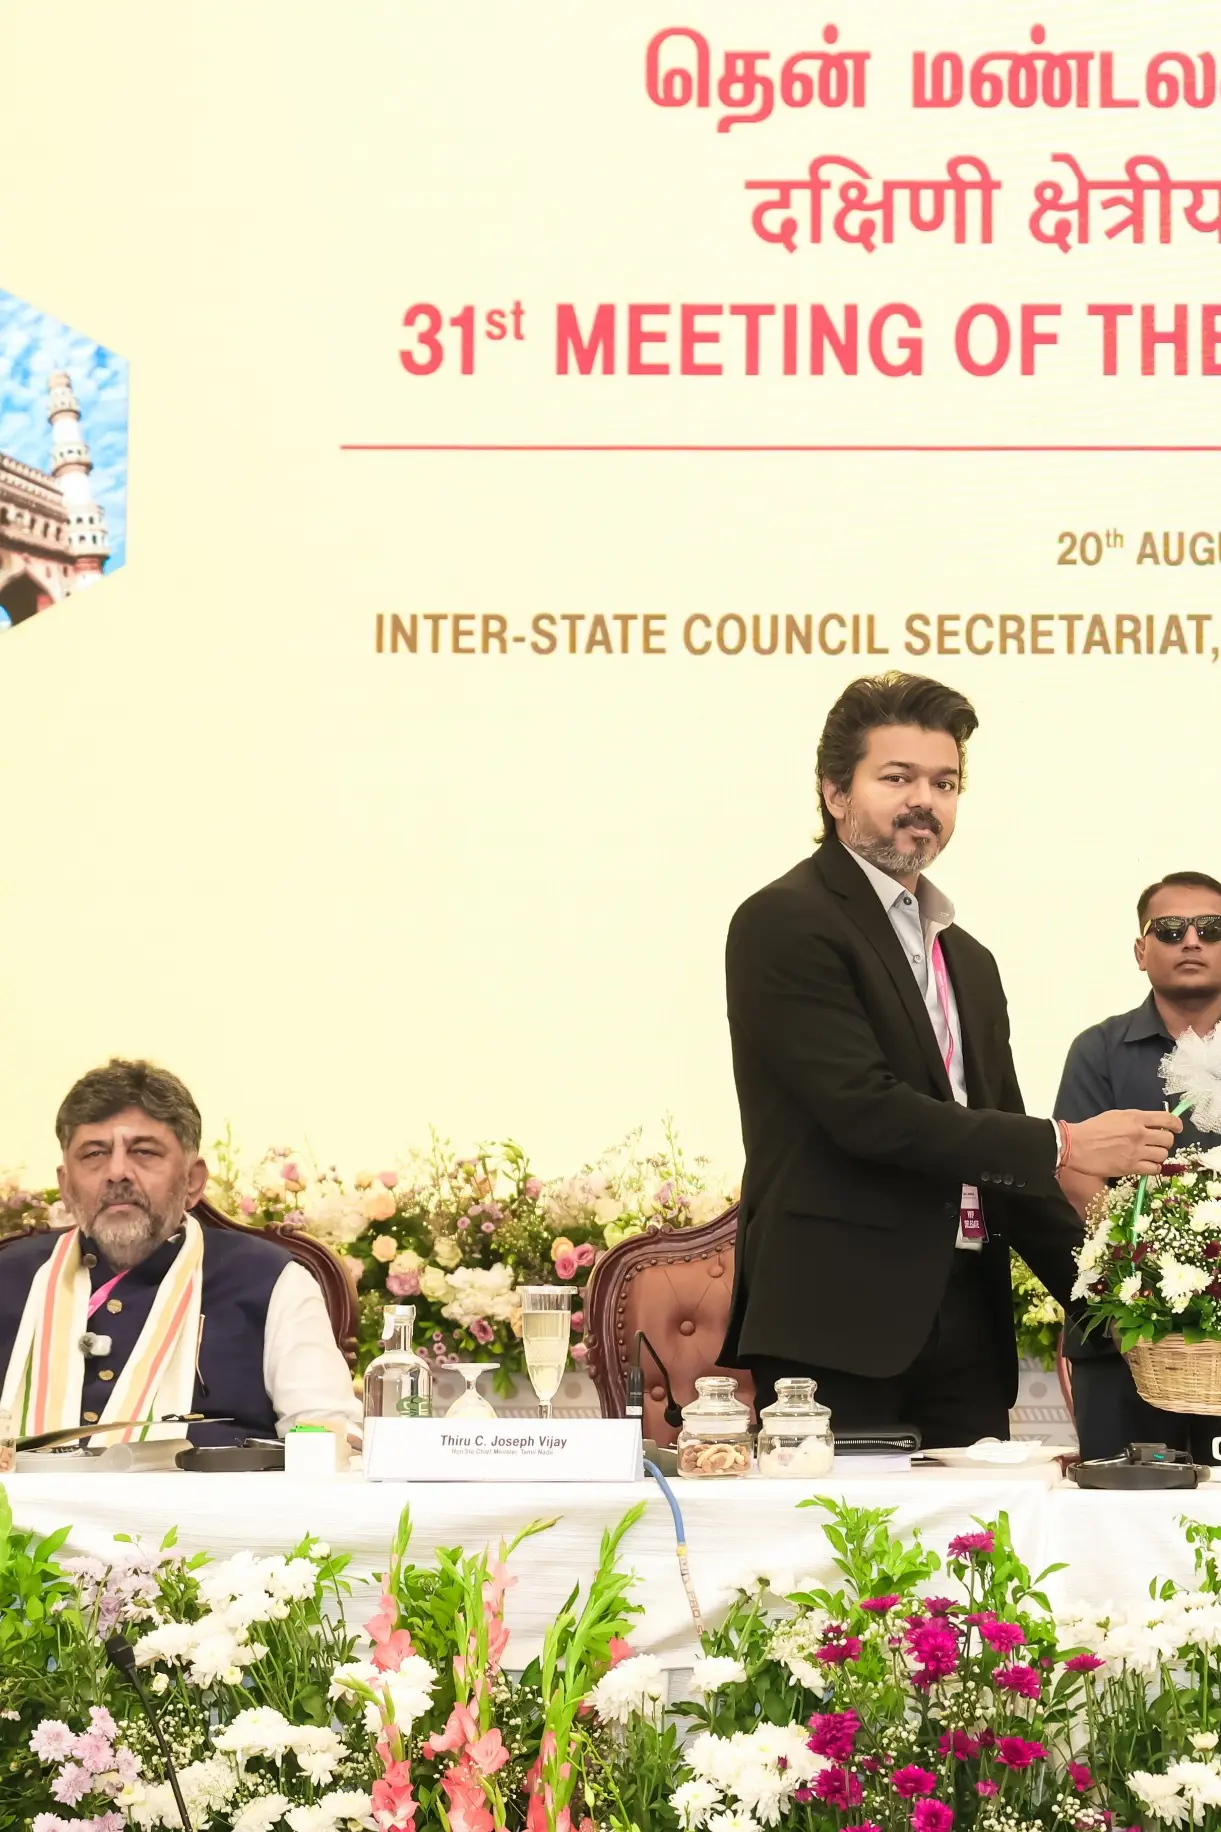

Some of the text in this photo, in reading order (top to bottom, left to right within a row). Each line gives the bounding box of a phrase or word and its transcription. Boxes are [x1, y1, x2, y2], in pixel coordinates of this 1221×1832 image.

[646, 24, 871, 133] தென்
[745, 155, 1002, 253] दक्षिणी
[400, 301, 524, 375] 31st
[556, 303, 922, 377] MEETING
[955, 303, 1061, 376] OF
[1058, 530, 1123, 566] 20th
[376, 613, 666, 655] INTER-STATE
[684, 613, 889, 655] COUNCIL
[905, 613, 1218, 663] SECRETARIAT,
[440, 1434, 567, 1449] Thiru C. Joseph Vijay
